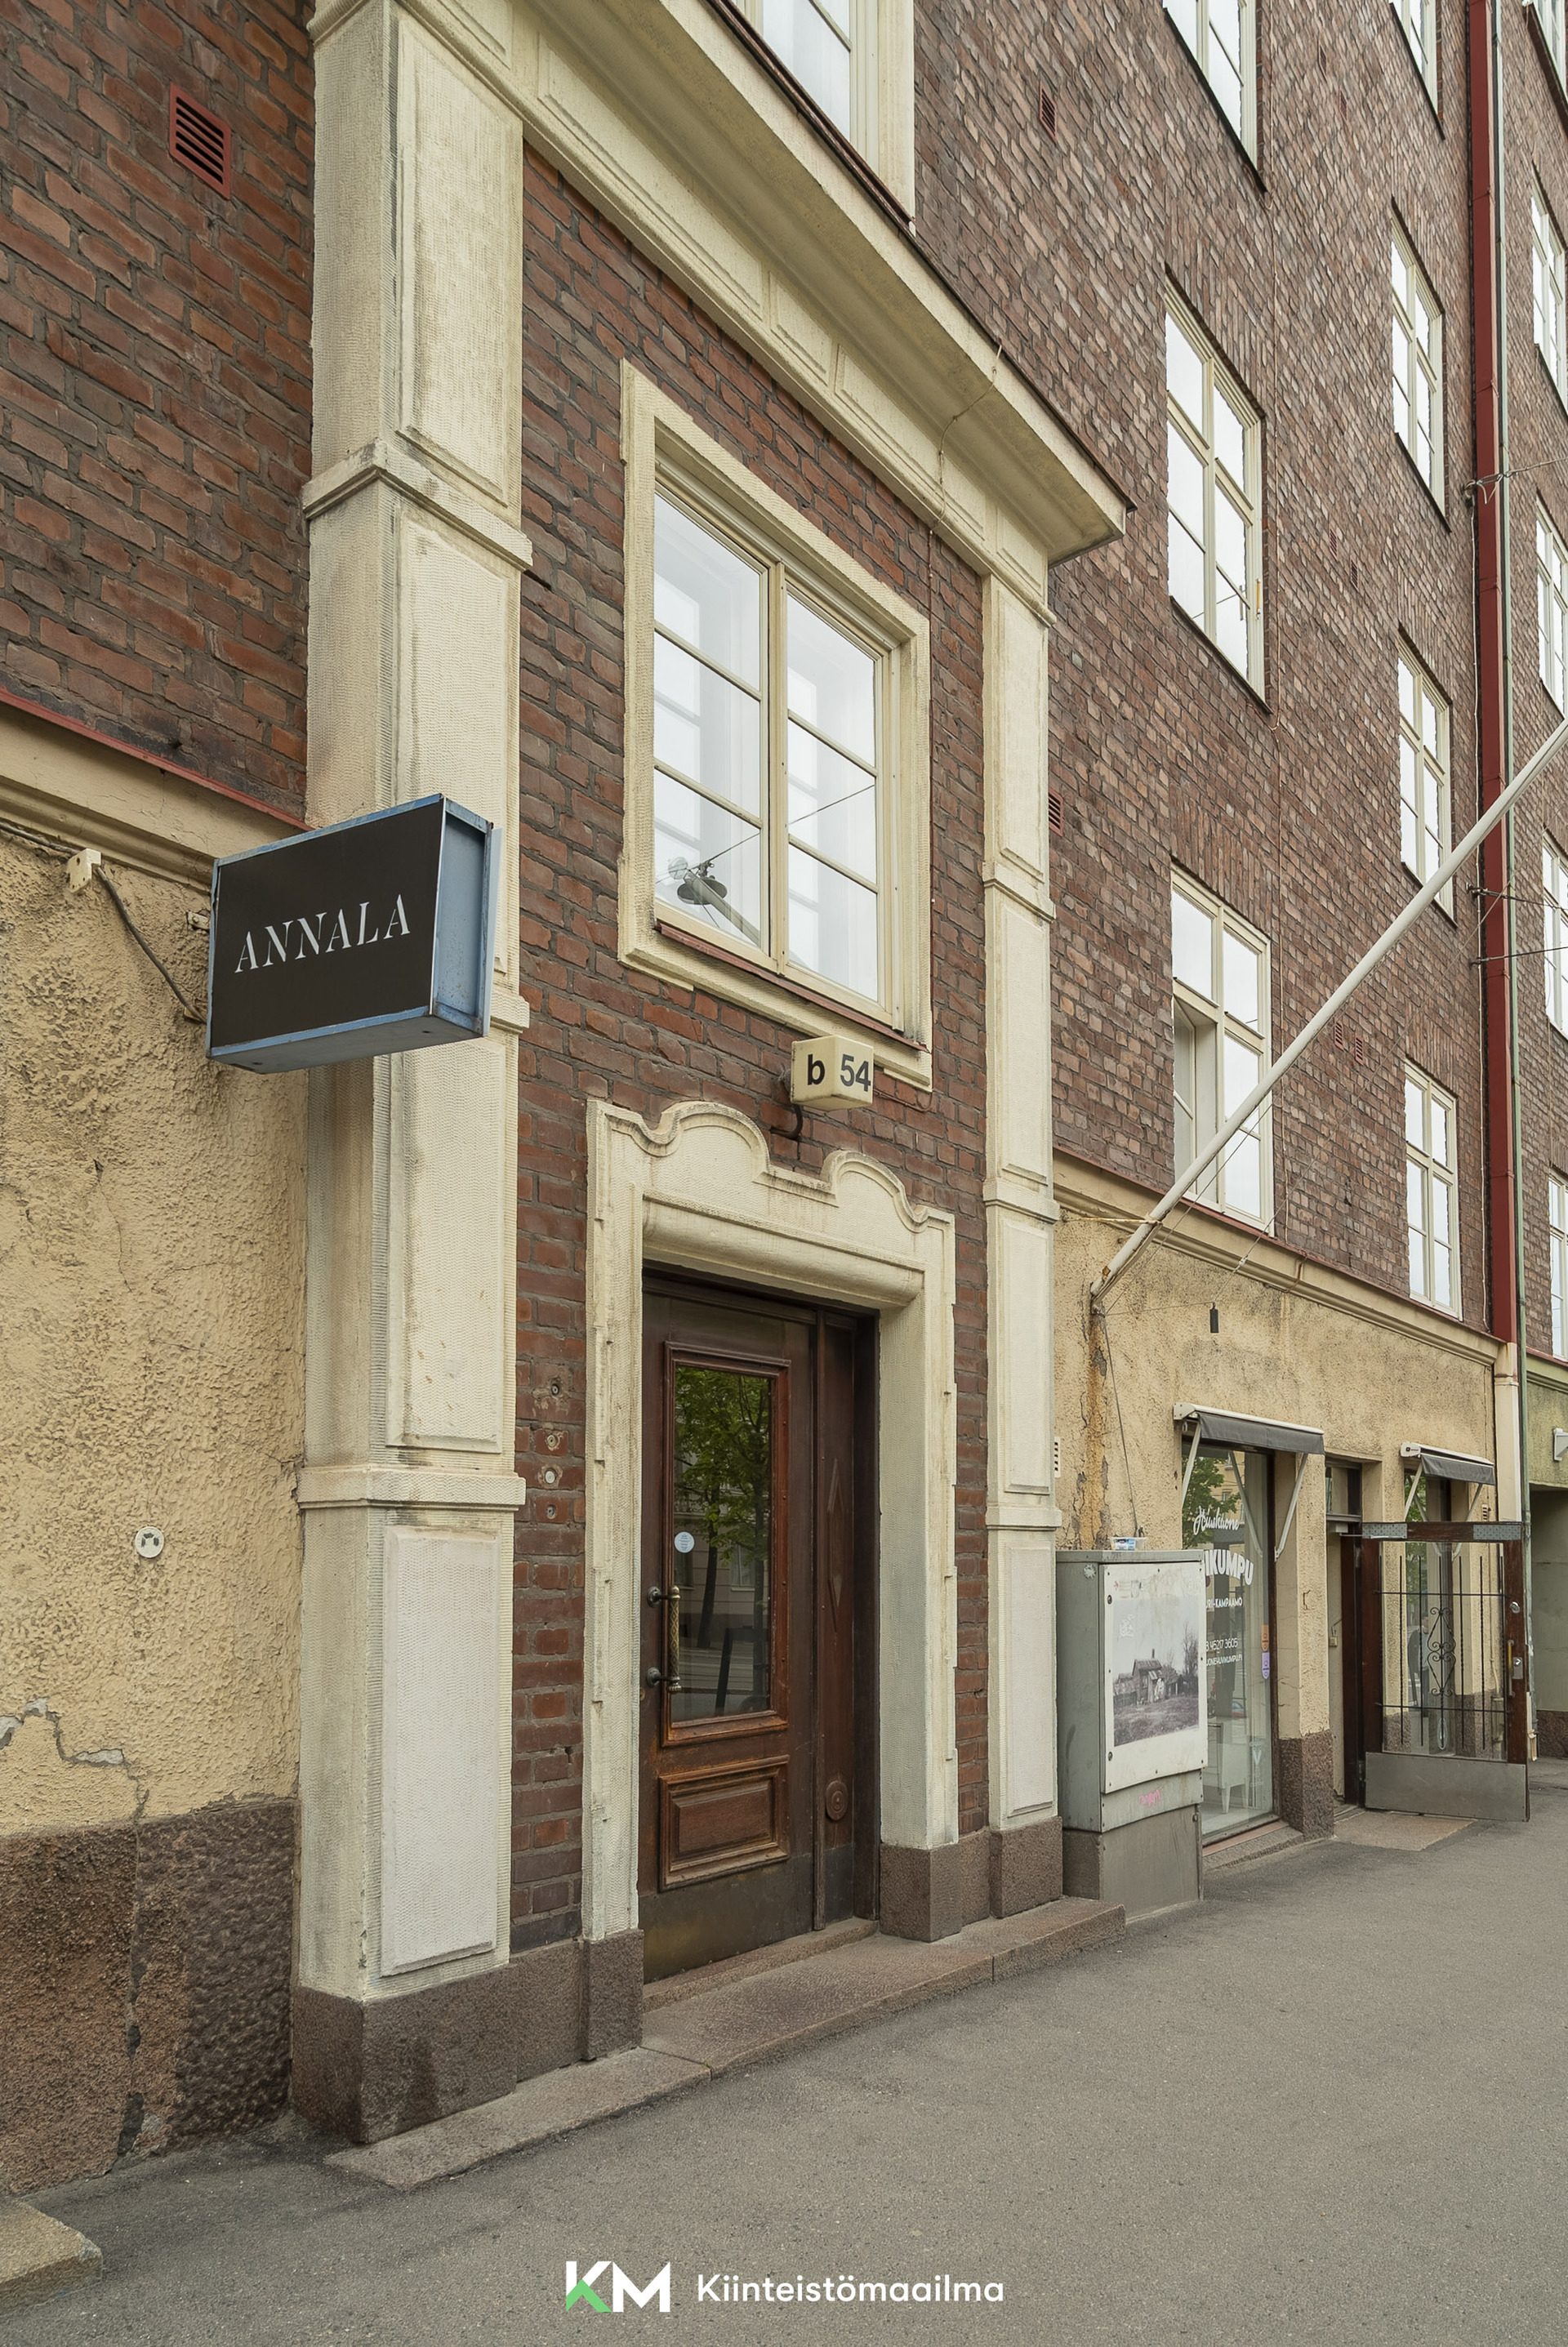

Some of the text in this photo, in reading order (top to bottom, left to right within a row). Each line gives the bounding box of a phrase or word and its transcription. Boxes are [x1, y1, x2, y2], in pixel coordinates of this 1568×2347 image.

[234, 894, 411, 973] ANNALA
[807, 1053, 826, 1086] b
[840, 1053, 871, 1092] 54
[1205, 1548, 1254, 1586] IKUMPU
